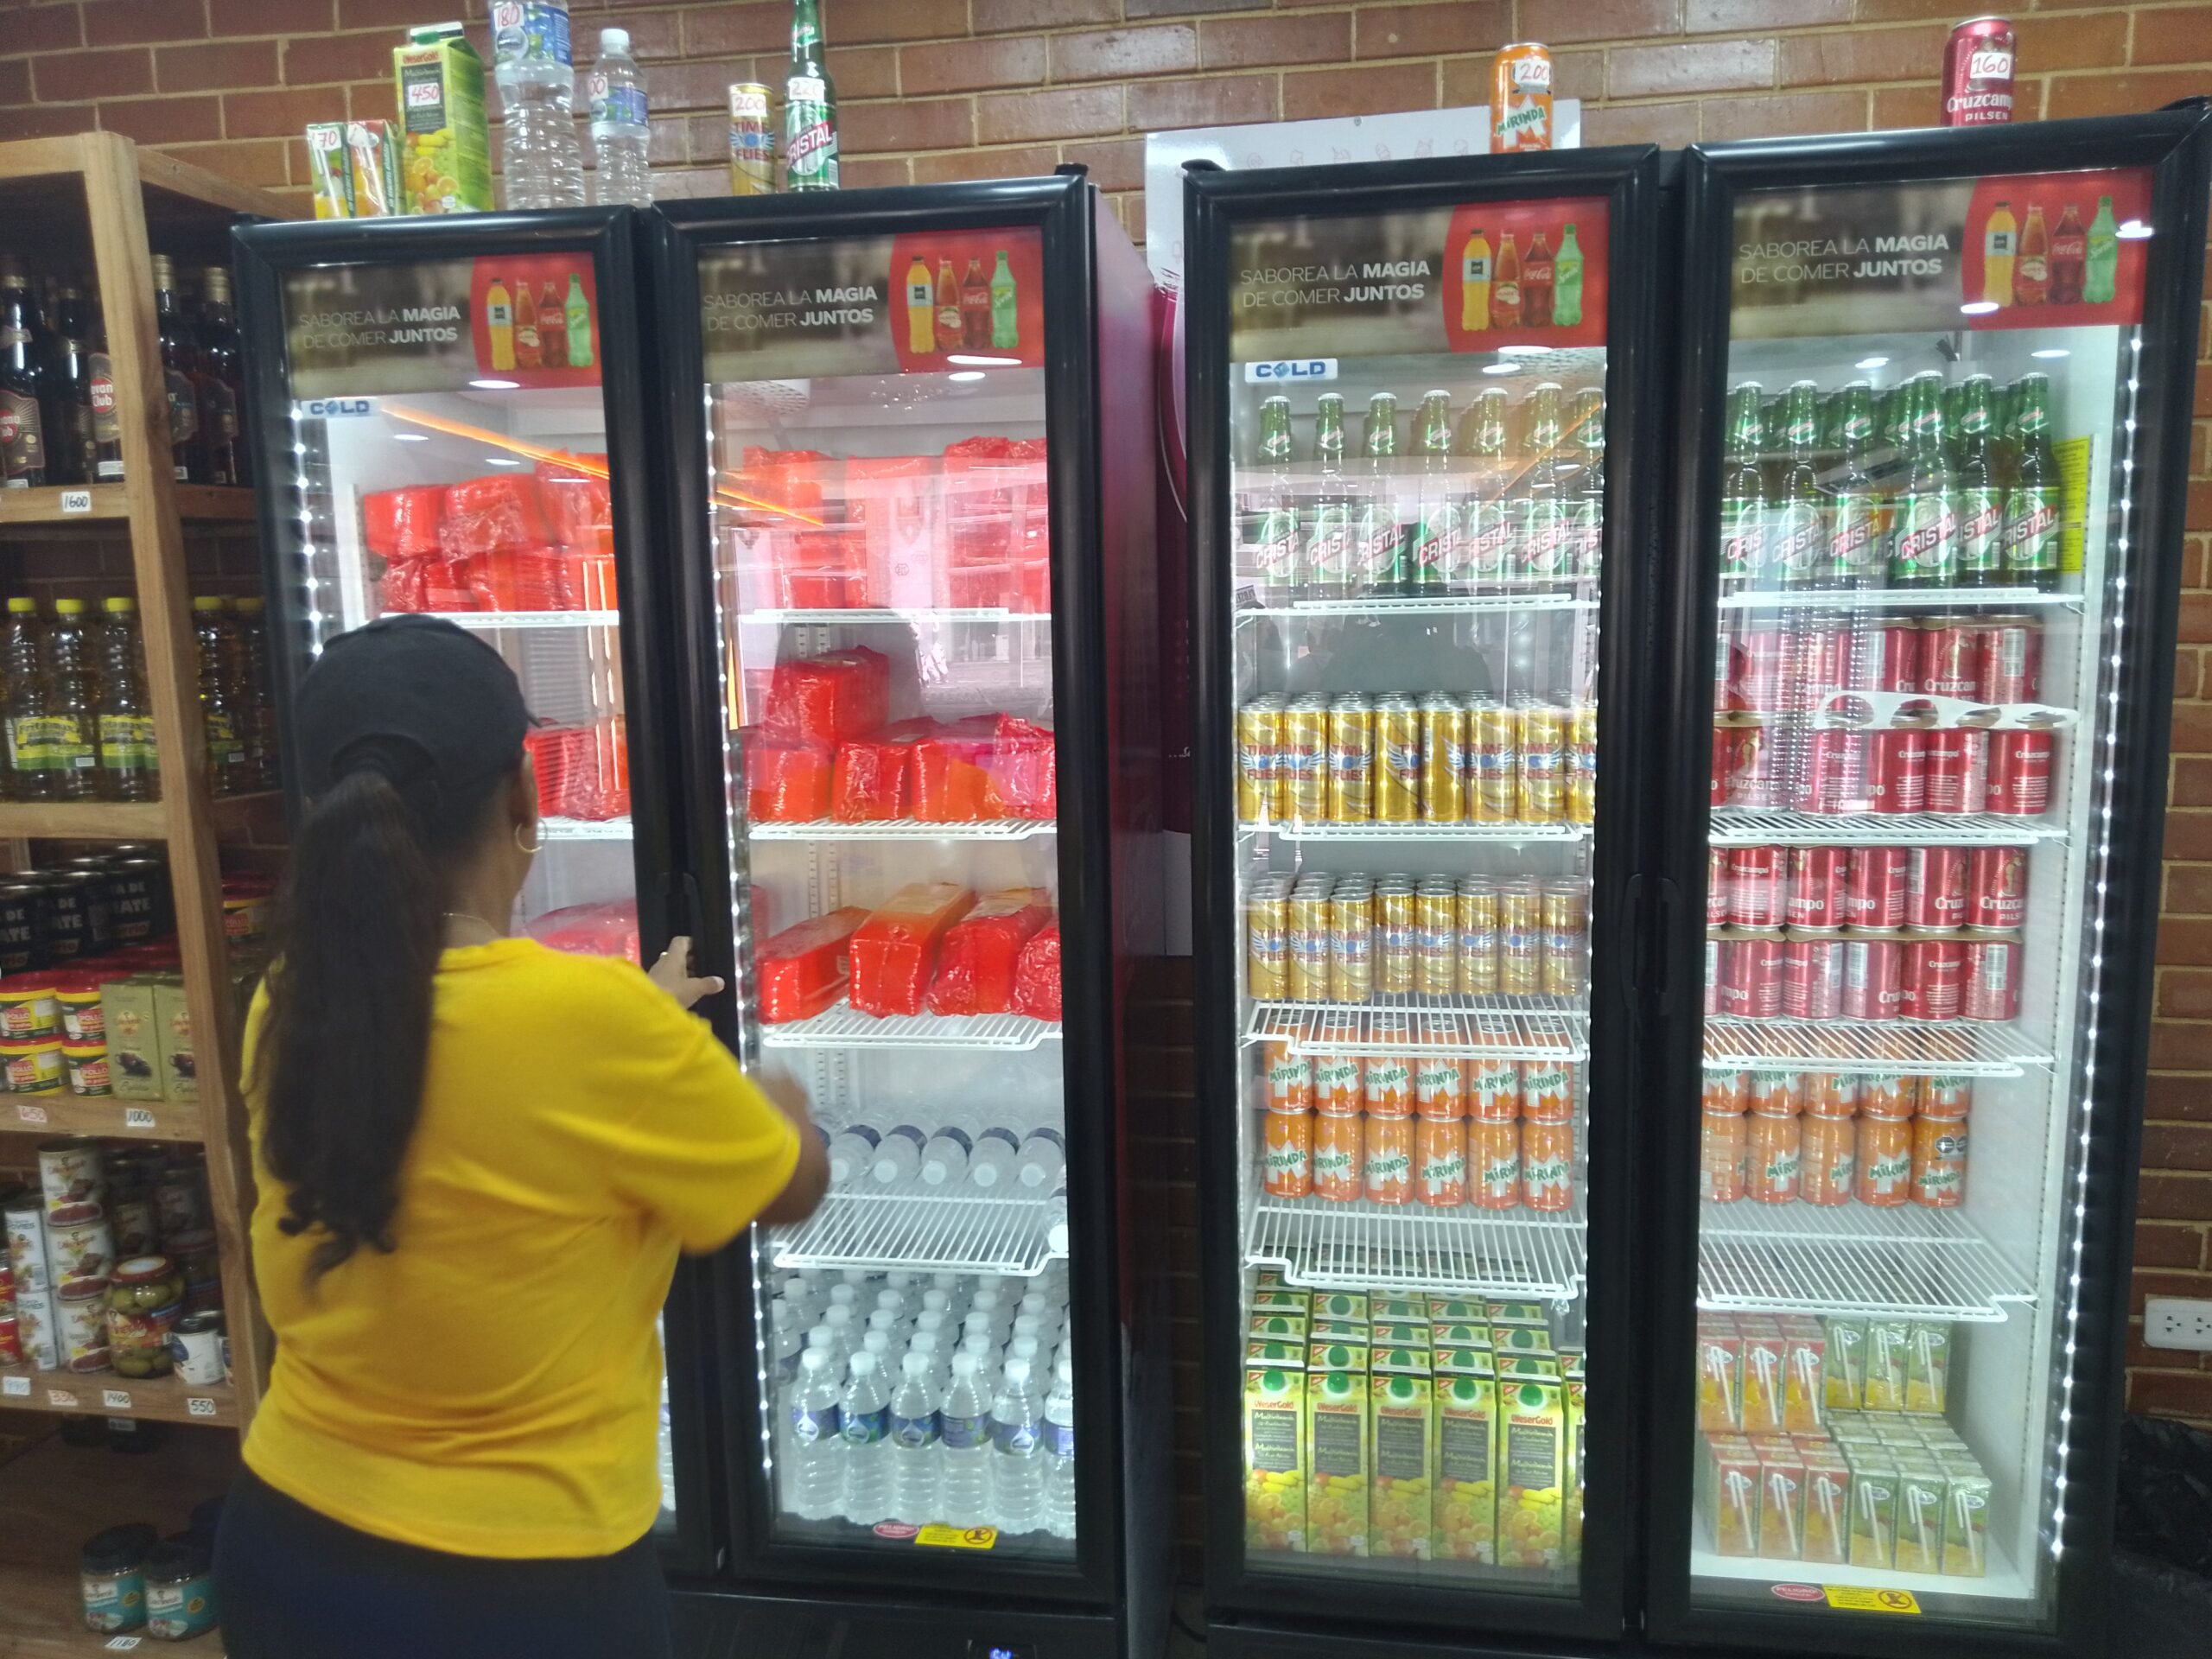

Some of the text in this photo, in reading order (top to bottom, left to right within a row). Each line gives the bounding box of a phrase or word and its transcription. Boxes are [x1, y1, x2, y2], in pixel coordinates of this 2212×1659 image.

[496, 8, 520, 27] 180
[1521, 63, 1548, 80] 200
[1973, 55, 2008, 74] 160
[411, 85, 439, 102] 450
[734, 96, 766, 111] 200
[1965, 111, 2009, 122] PILSEN
[734, 121, 770, 134] TIME
[735, 148, 771, 162] FLIES
[1738, 233, 1950, 260] SABOREA LA MAGIA
[1241, 260, 1431, 285] SABOREA LA MAGIA
[1741, 257, 1943, 283] DE COMER JUNTOS
[703, 285, 878, 309] SABOREA LA MAGIA
[1243, 283, 1426, 308] DE COMER JUNTOS
[299, 306, 461, 327] SABOREA LA MAGIA
[707, 308, 874, 332] DE COMER JUNTOS
[303, 327, 458, 349] DE COMER JUNTOS
[92, 396, 113, 408] Club
[64, 494, 88, 509] 1600
[1901, 514, 1956, 560] CRISTAL
[128, 1109, 153, 1122] 1000
[106, 1394, 130, 1404] 1400
[191, 1399, 215, 1413] 550
[1255, 1401, 1294, 1409] WeserGold
[1317, 1402, 1357, 1412] WeserGold
[1380, 1406, 1421, 1416] WeserGold
[1444, 1408, 1486, 1419] WeserGold
[1511, 1414, 1554, 1425] WeserGold
